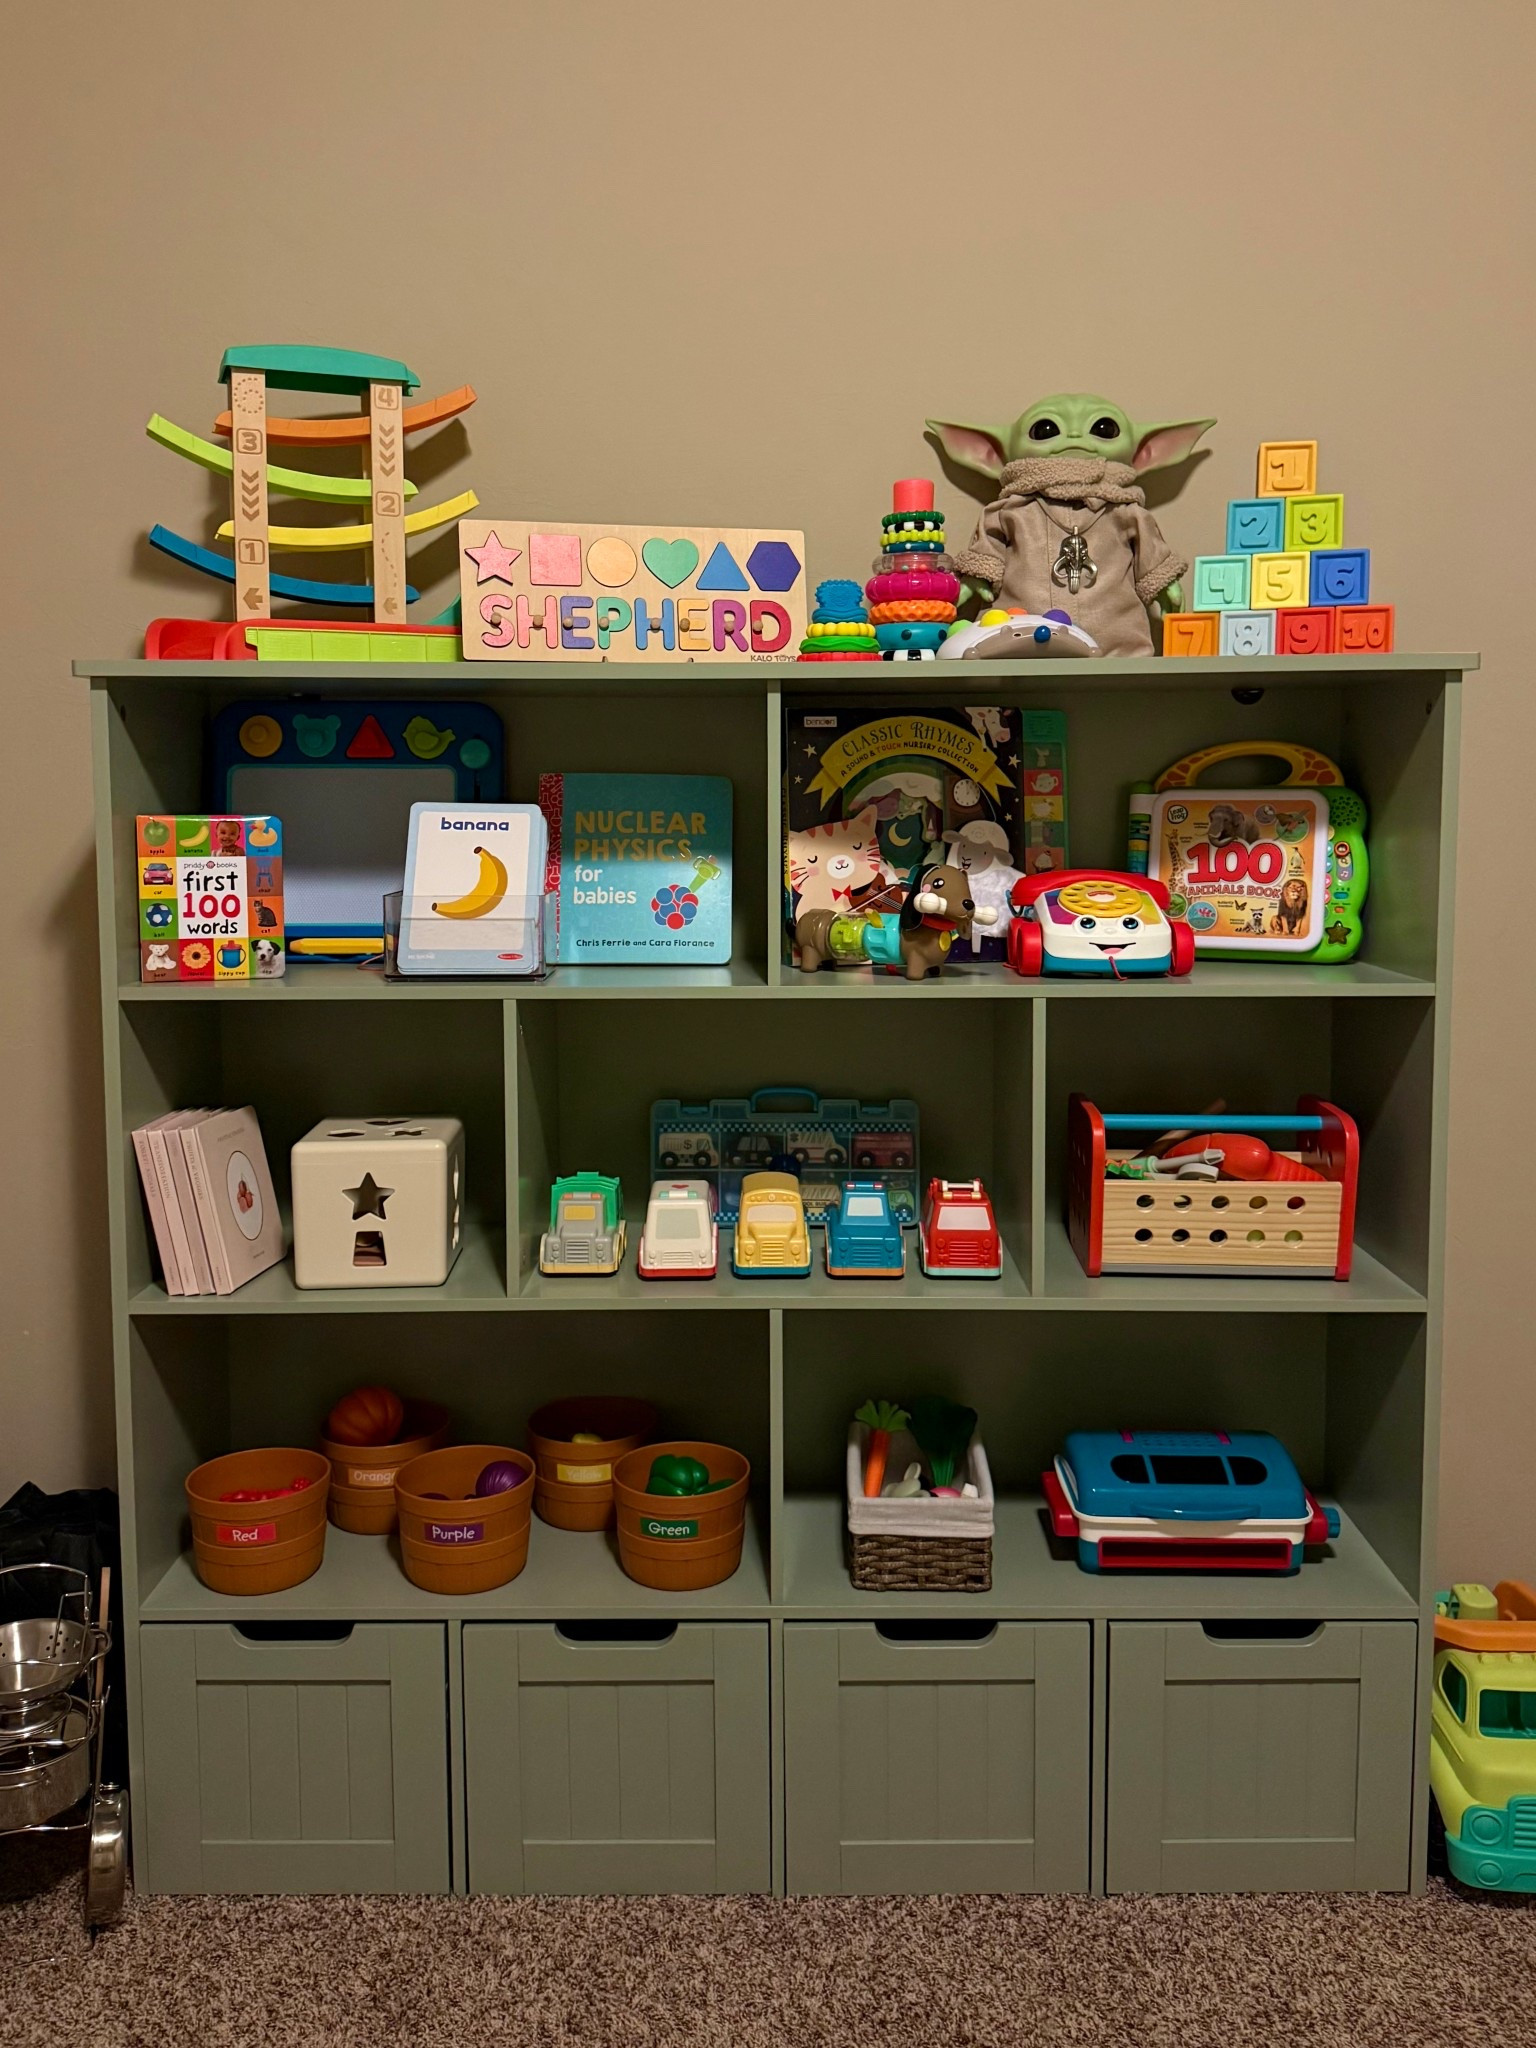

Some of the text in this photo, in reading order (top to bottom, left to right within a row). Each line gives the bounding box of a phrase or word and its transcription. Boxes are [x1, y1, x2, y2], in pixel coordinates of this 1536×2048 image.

[378, 386, 394, 407] 4
[241, 431, 257, 451] 3
[1270, 456, 1305, 491] 1
[380, 494, 395, 513] 2
[1239, 510, 1328, 548] 2 3
[245, 542, 256, 561] 1
[1208, 559, 1355, 604] 4 5 6
[479, 593, 792, 652] SHEPHERD
[1177, 617, 1386, 657] 7 8 9 10
[805, 718, 837, 727] bendon
[842, 721, 975, 757] CLASSIC RHYMES
[840, 770, 848, 778] A
[846, 753, 870, 772] SOUND
[877, 743, 901, 754] TOUCH
[903, 741, 936, 751] NURSERY
[937, 746, 979, 774] COLLECTION
[440, 817, 510, 832] banana
[575, 811, 707, 835] NUCLEAR
[574, 838, 692, 862] PHYSICS
[183, 861, 206, 871] priddy
[1187, 841, 1284, 884] 100
[183, 871, 239, 892] first
[574, 865, 603, 882] for
[573, 887, 638, 906] babies
[1188, 884, 1282, 899] ANIMALS BOOK
[182, 893, 241, 918] 100
[187, 919, 239, 935] words
[576, 939, 600, 947] Chris
[601, 939, 631, 947] Ferrie
[648, 939, 672, 947] Cara
[673, 939, 715, 948] Florance
[232, 1529, 258, 1542] Red
[433, 1525, 475, 1543] Purple
[648, 1522, 690, 1536] Green
